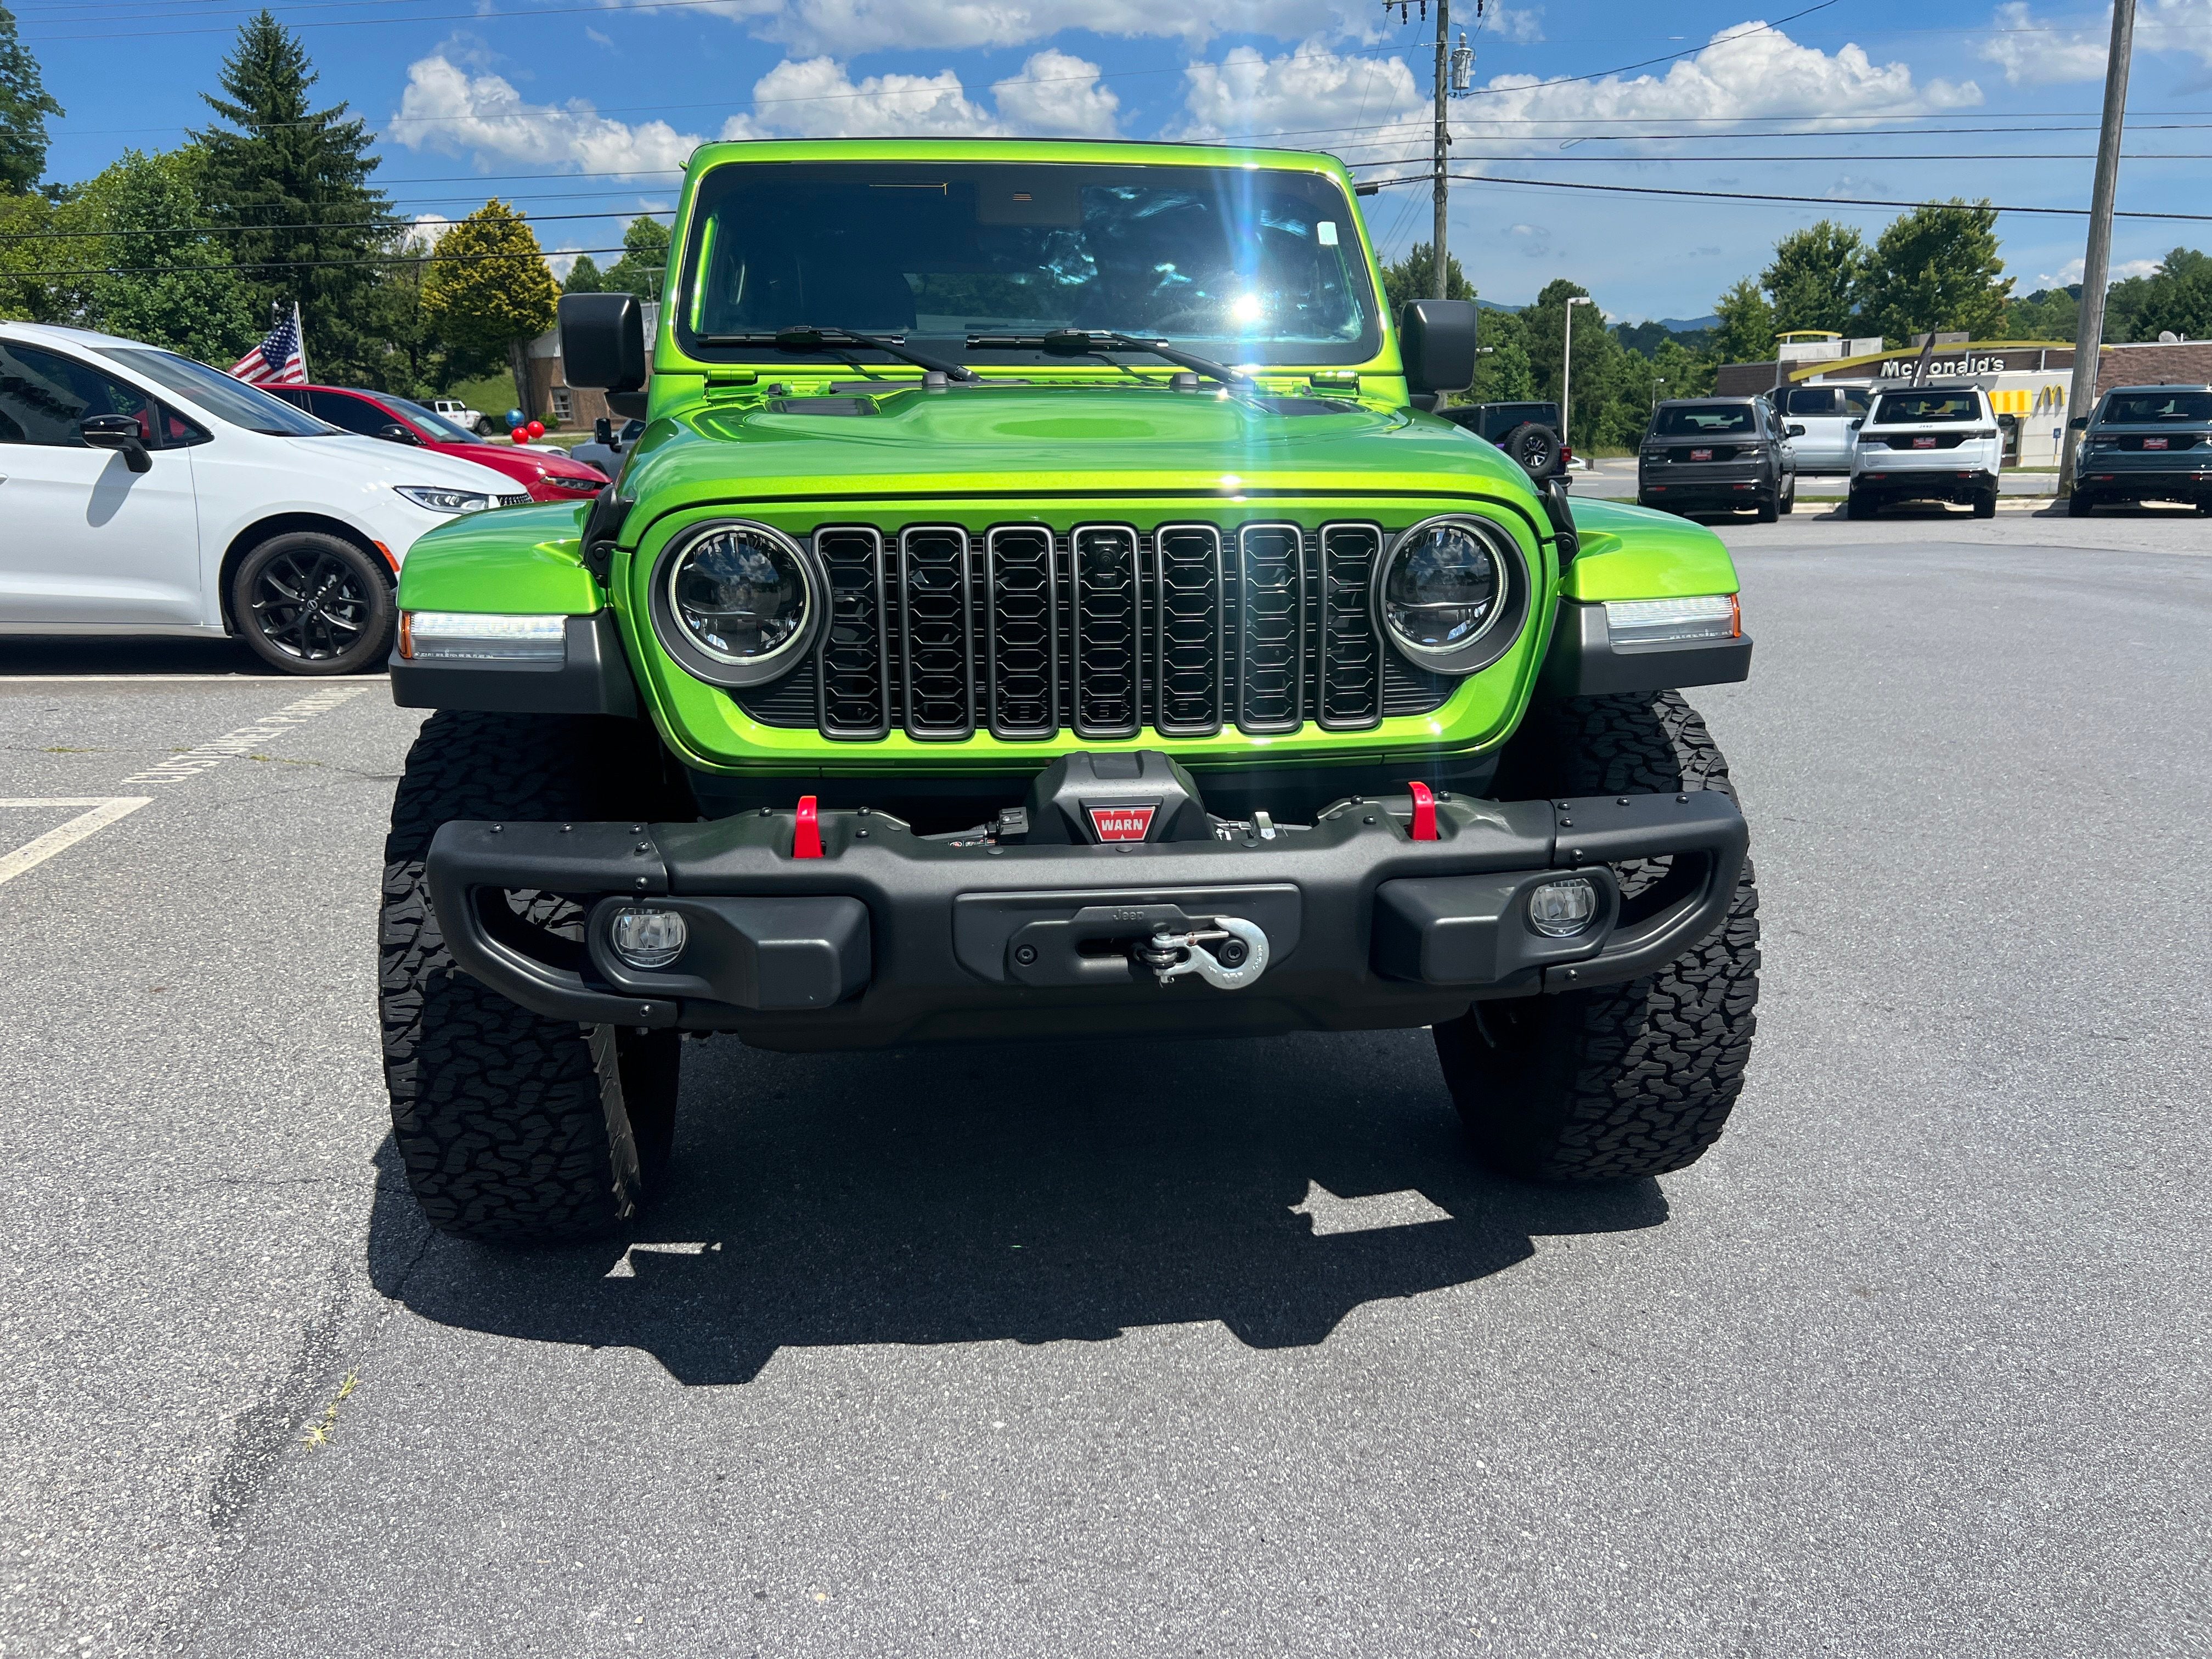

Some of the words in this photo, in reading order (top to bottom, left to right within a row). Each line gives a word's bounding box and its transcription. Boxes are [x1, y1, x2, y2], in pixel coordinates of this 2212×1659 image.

[1880, 357, 2005, 378] Mconald's
[1101, 819, 1143, 831] WARN
[1112, 909, 1145, 921] Jeep
